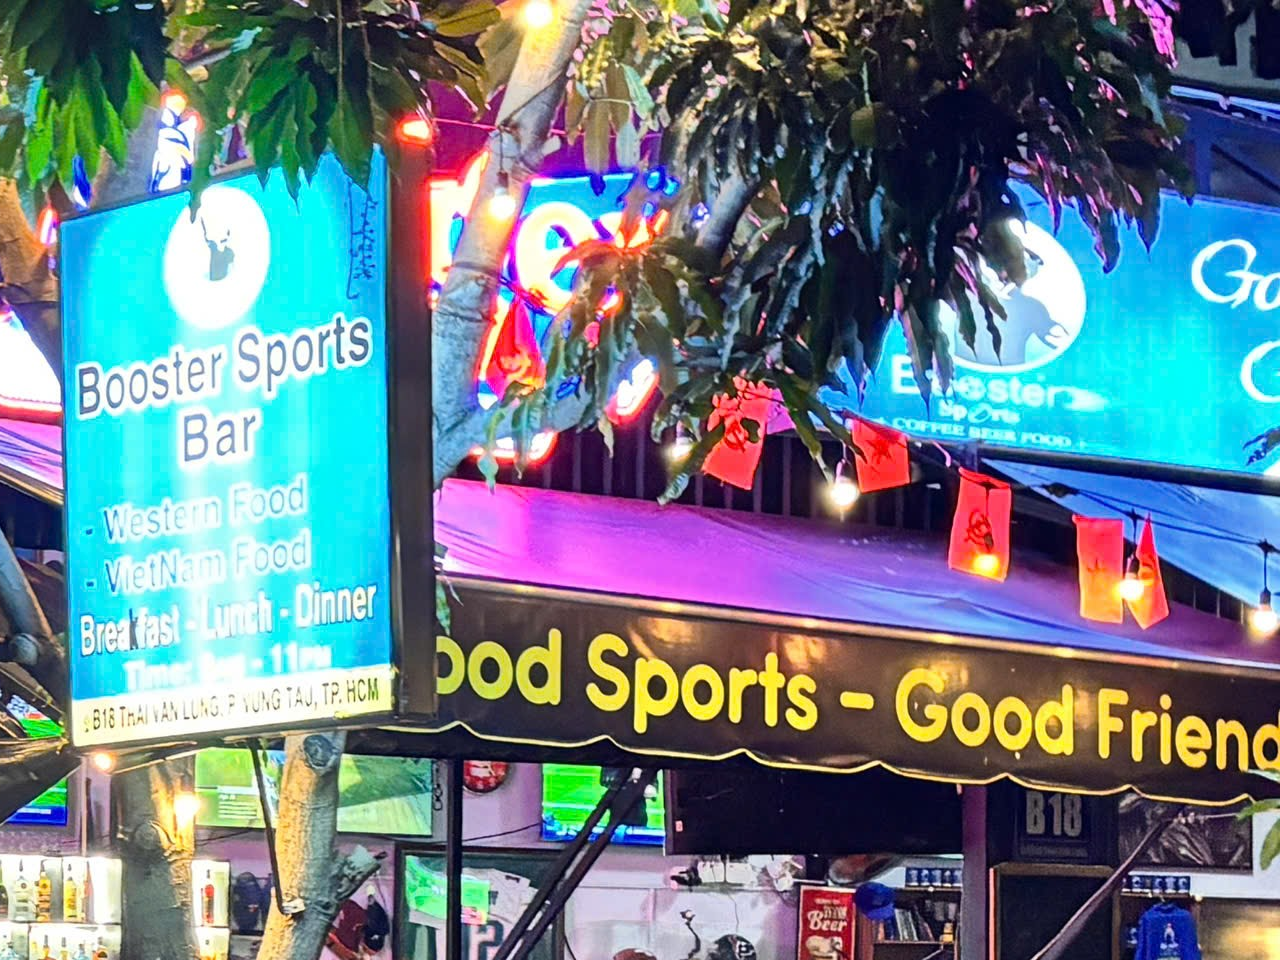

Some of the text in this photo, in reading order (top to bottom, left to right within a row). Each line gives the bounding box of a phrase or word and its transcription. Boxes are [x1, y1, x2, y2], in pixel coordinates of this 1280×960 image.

[78, 316, 370, 416] Booster Sports
[182, 413, 256, 463] Bar
[104, 498, 222, 542] Western
[231, 479, 308, 519] Food
[105, 549, 224, 594] VietNam
[233, 533, 311, 576] Food
[80, 607, 181, 657] Breakfast
[202, 592, 274, 639] Lunch
[296, 583, 378, 630] Dinner
[92, 707, 117, 731] B18
[346, 677, 380, 704] HCM
[586, 632, 818, 733] Sports
[895, 667, 1074, 756] Good
[807, 909, 848, 933] Beer
